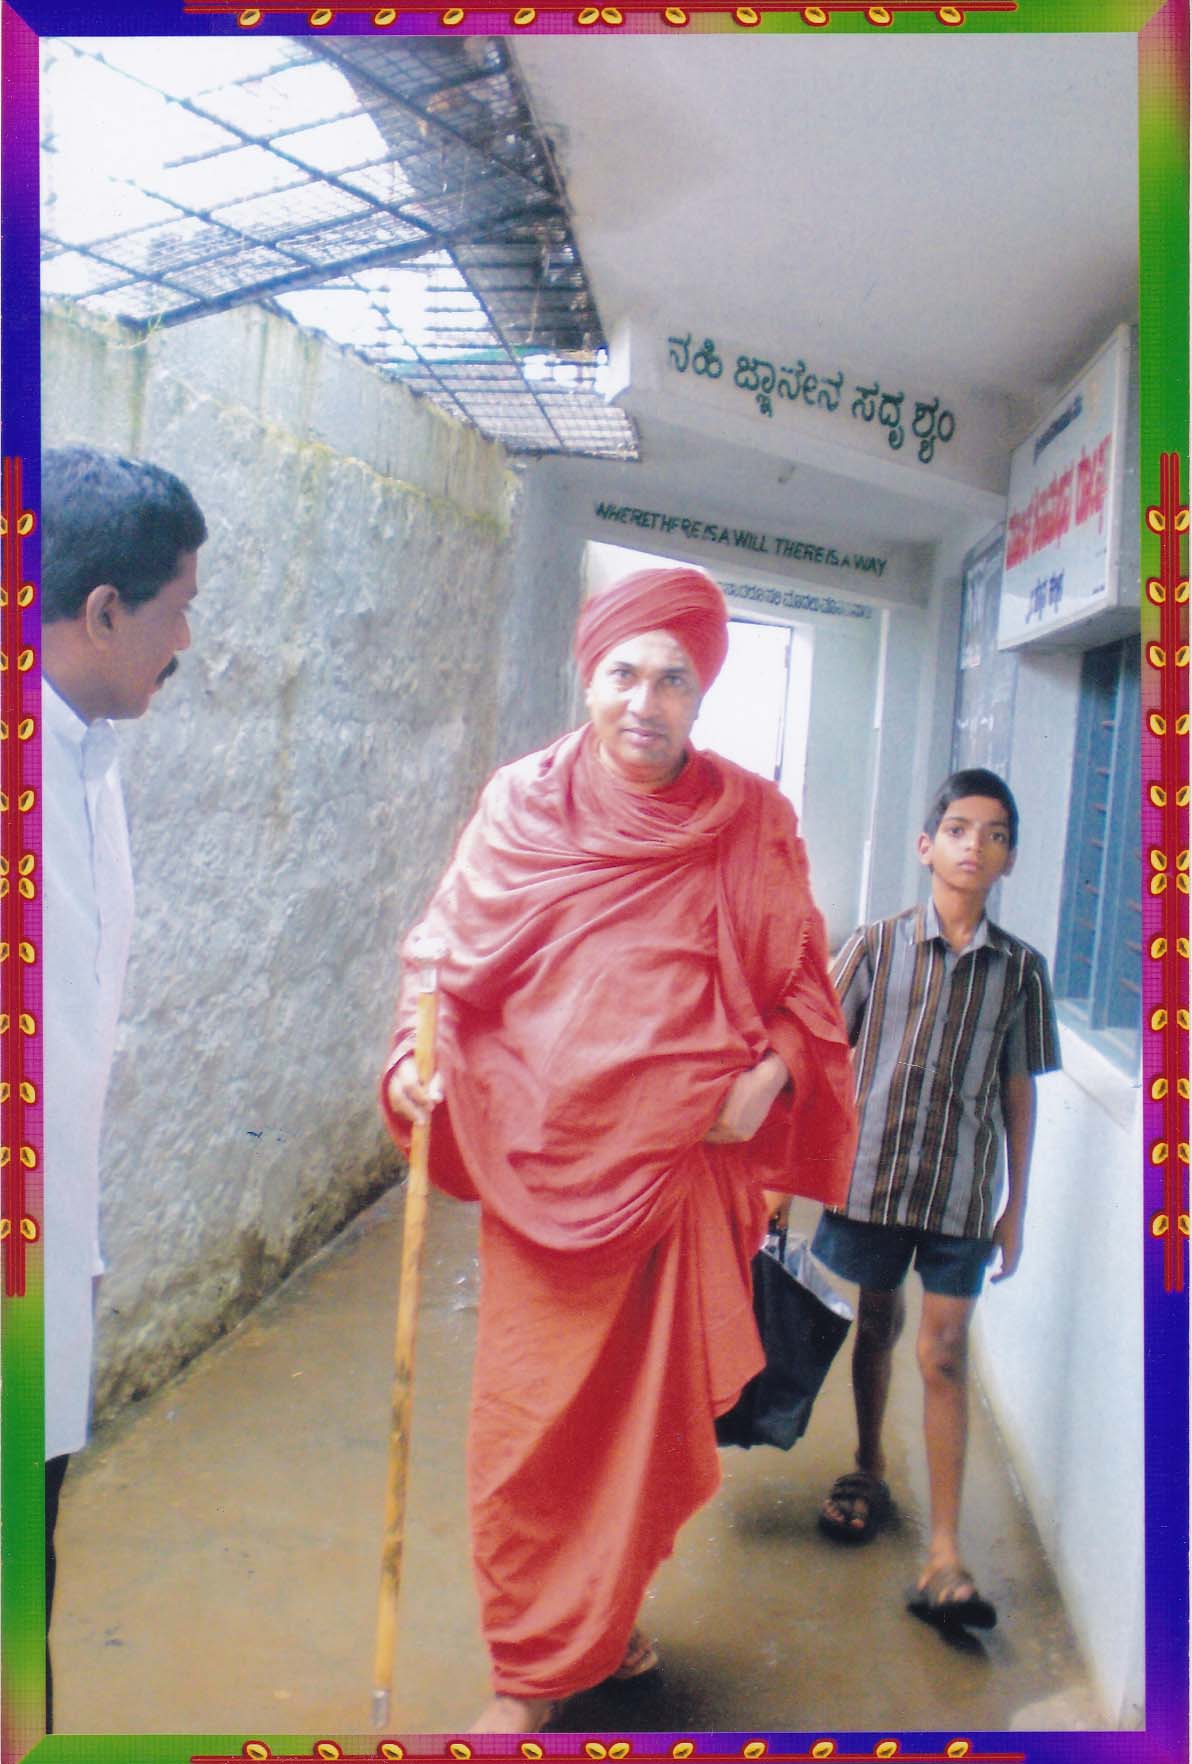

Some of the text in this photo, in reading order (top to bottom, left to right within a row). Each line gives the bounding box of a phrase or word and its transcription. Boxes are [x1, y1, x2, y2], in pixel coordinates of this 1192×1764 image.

[701, 524, 718, 541] IS
[716, 527, 730, 544] A
[733, 528, 768, 553] WILL
[774, 538, 826, 563] THERE
[824, 549, 840, 566] IS
[840, 554, 852, 568] A
[852, 553, 888, 577] WAY
